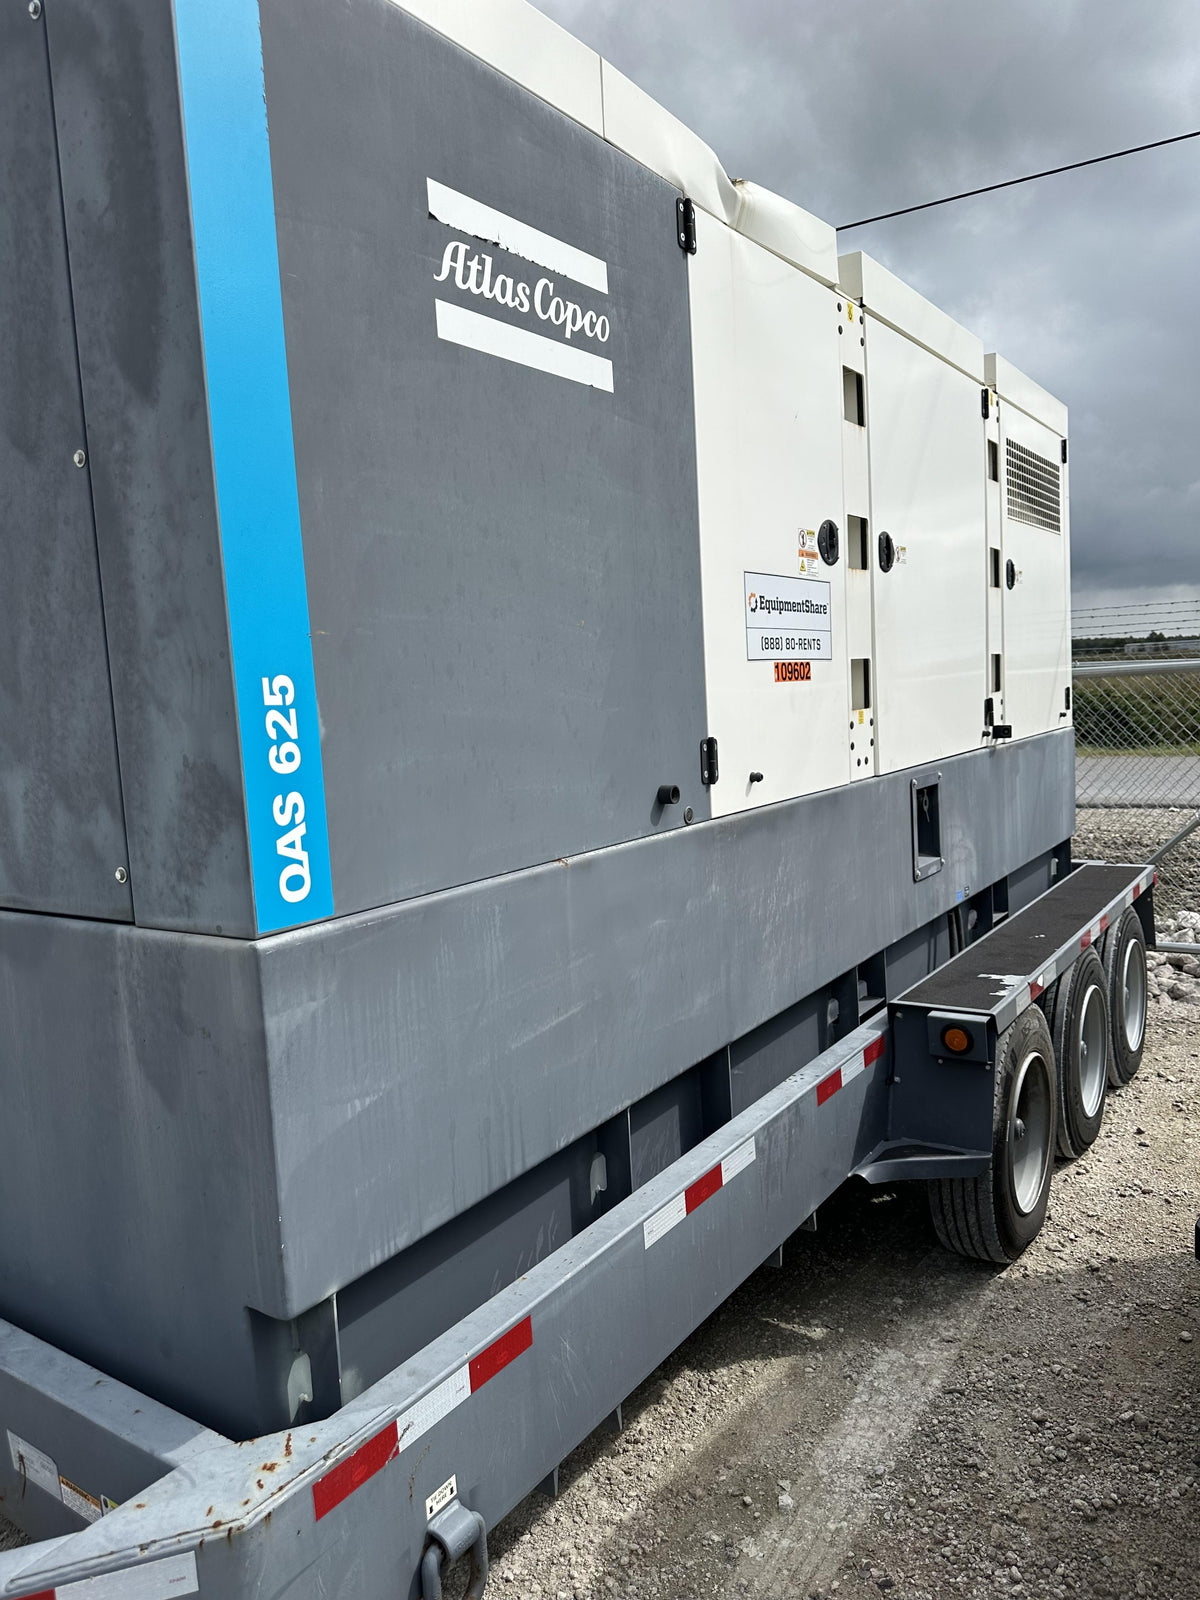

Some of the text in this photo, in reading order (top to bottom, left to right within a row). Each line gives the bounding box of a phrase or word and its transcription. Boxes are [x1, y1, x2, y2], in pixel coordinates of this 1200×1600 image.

[433, 241, 610, 342] Atlas Copco
[759, 595, 827, 615] EquipmentShare
[761, 636, 821, 651] (888) 80-RENTS
[774, 662, 811, 682] 109602
[262, 674, 311, 903] QAS 625
